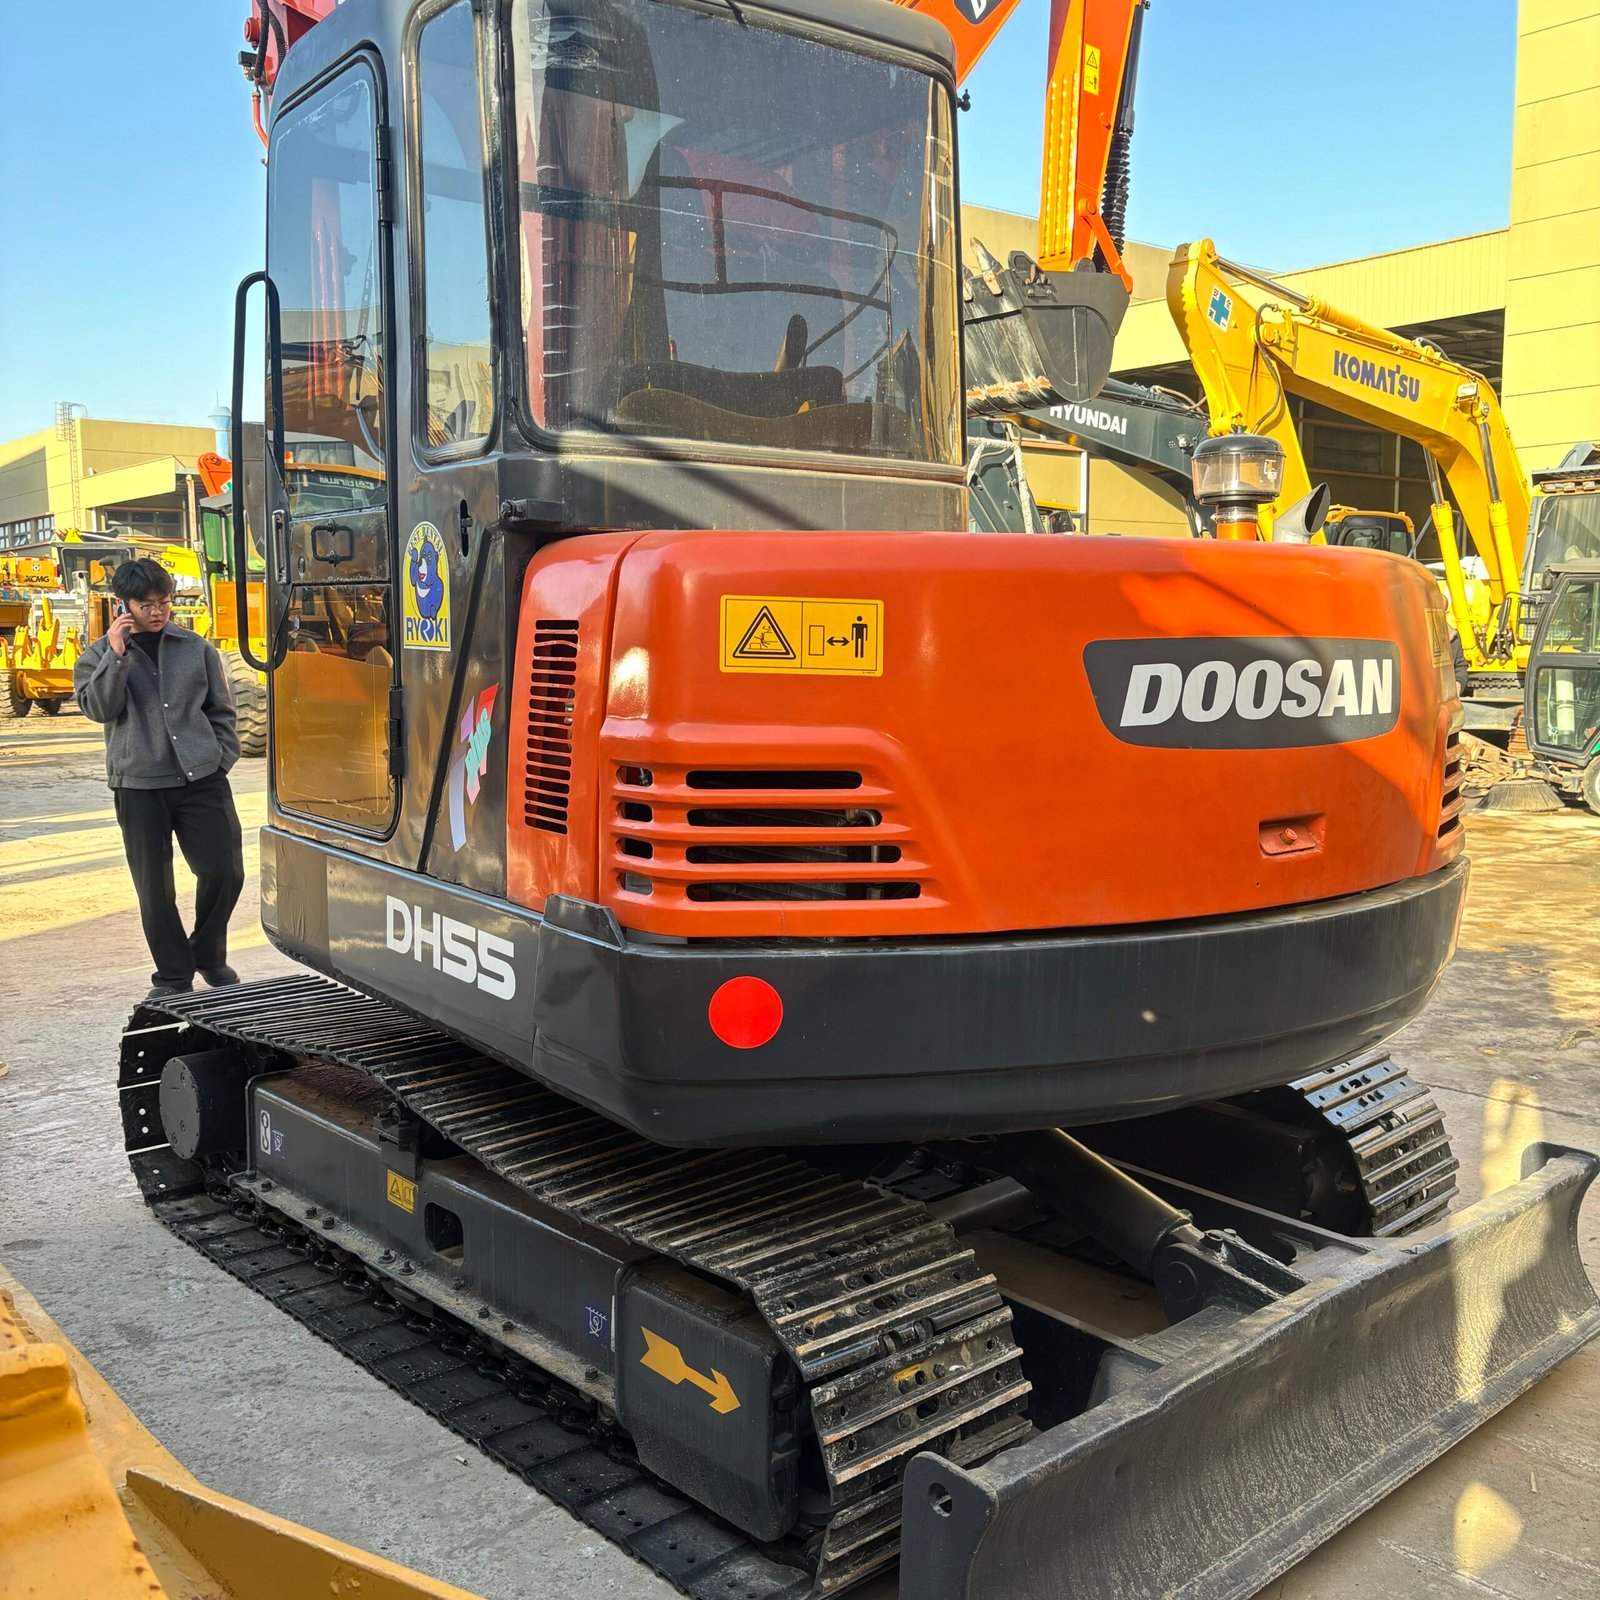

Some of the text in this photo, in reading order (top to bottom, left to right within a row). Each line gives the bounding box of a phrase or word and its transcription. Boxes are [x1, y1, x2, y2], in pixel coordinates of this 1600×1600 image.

[1333, 350, 1420, 402] KOMATSU
[1049, 404, 1128, 435] HYUNDAI
[24, 575, 50, 583] XCMG
[1119, 659, 1393, 727] DOOSAN
[386, 895, 516, 1001] DH55
